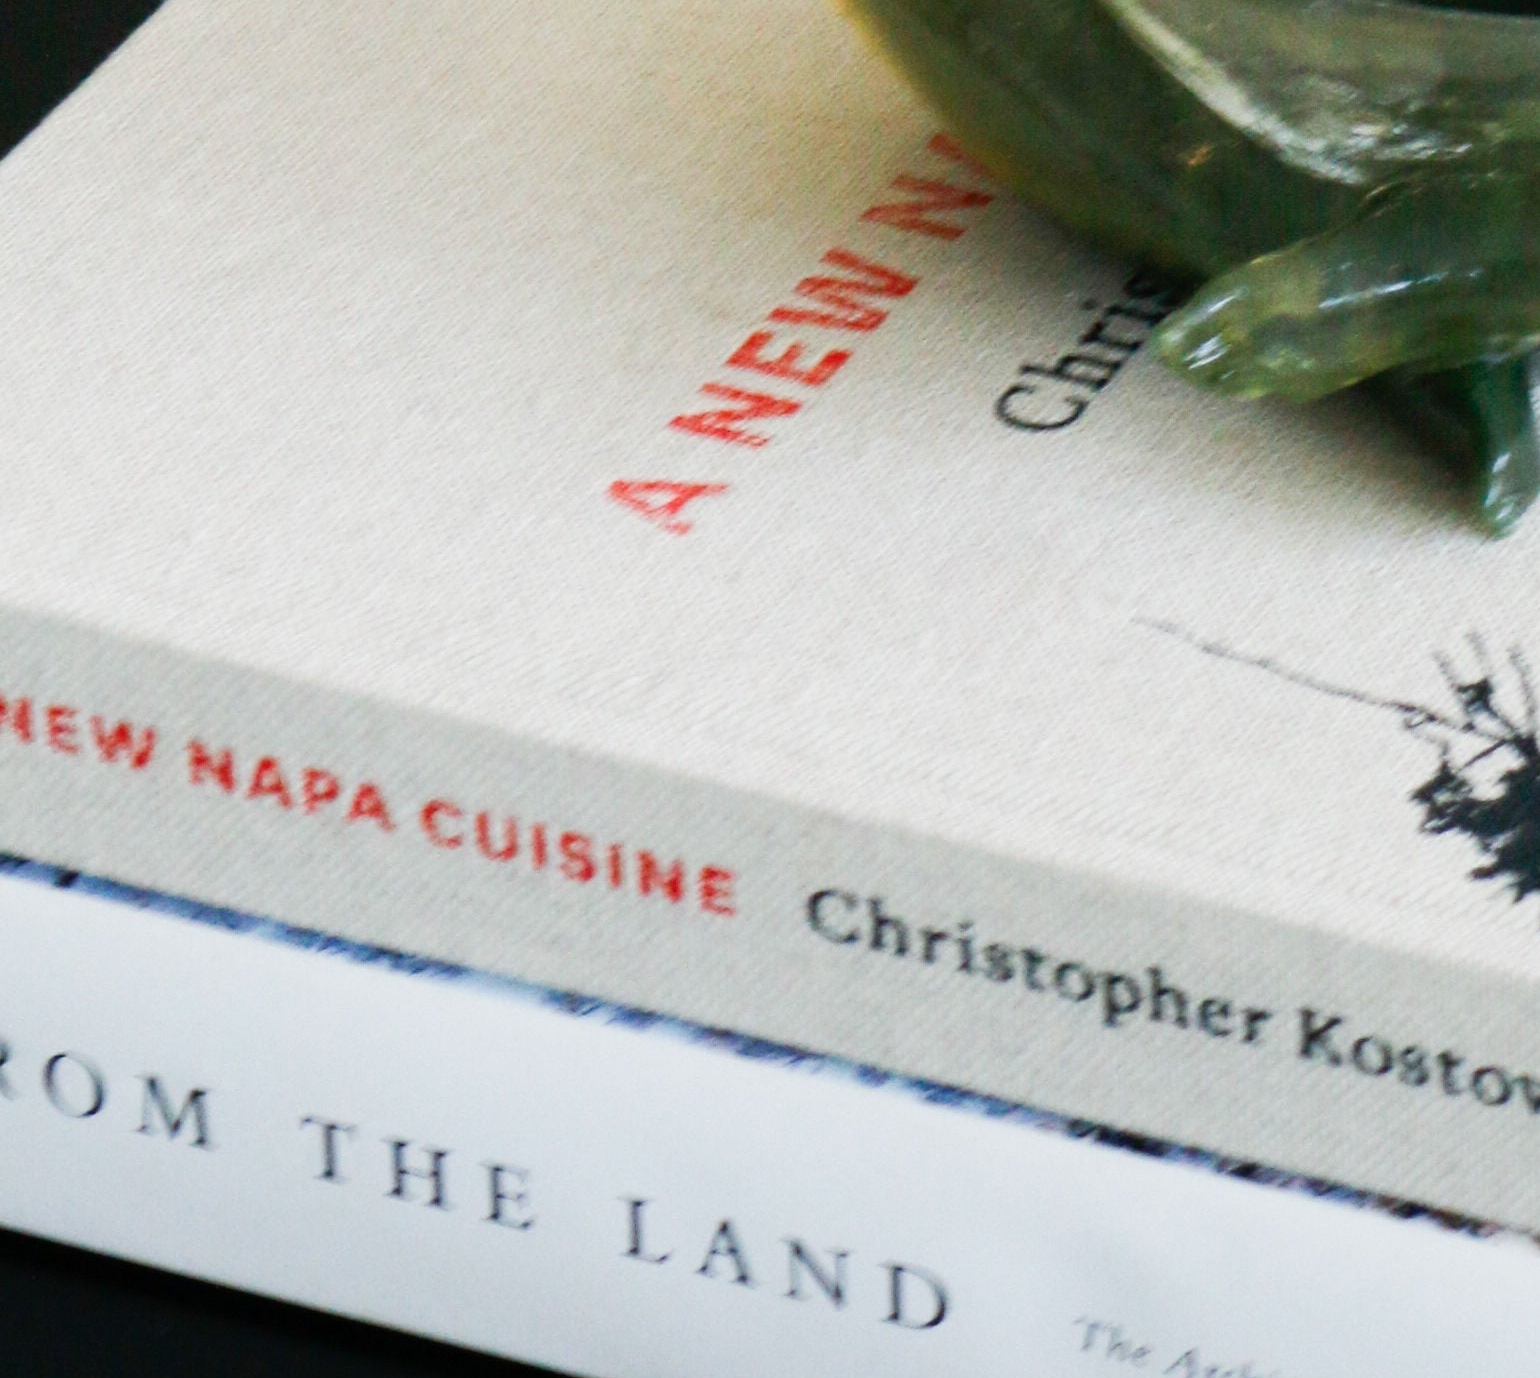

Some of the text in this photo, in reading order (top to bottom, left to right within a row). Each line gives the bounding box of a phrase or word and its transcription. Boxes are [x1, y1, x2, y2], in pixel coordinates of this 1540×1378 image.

[667, 245, 920, 448] NEW
[607, 479, 731, 534] A
[187, 740, 397, 833] NAPA
[419, 799, 736, 917] CUISINE
[805, 886, 1273, 1043] Christopher
[0, 1037, 951, 1330] OM THE LAND
[1074, 1314, 1151, 1368] The
